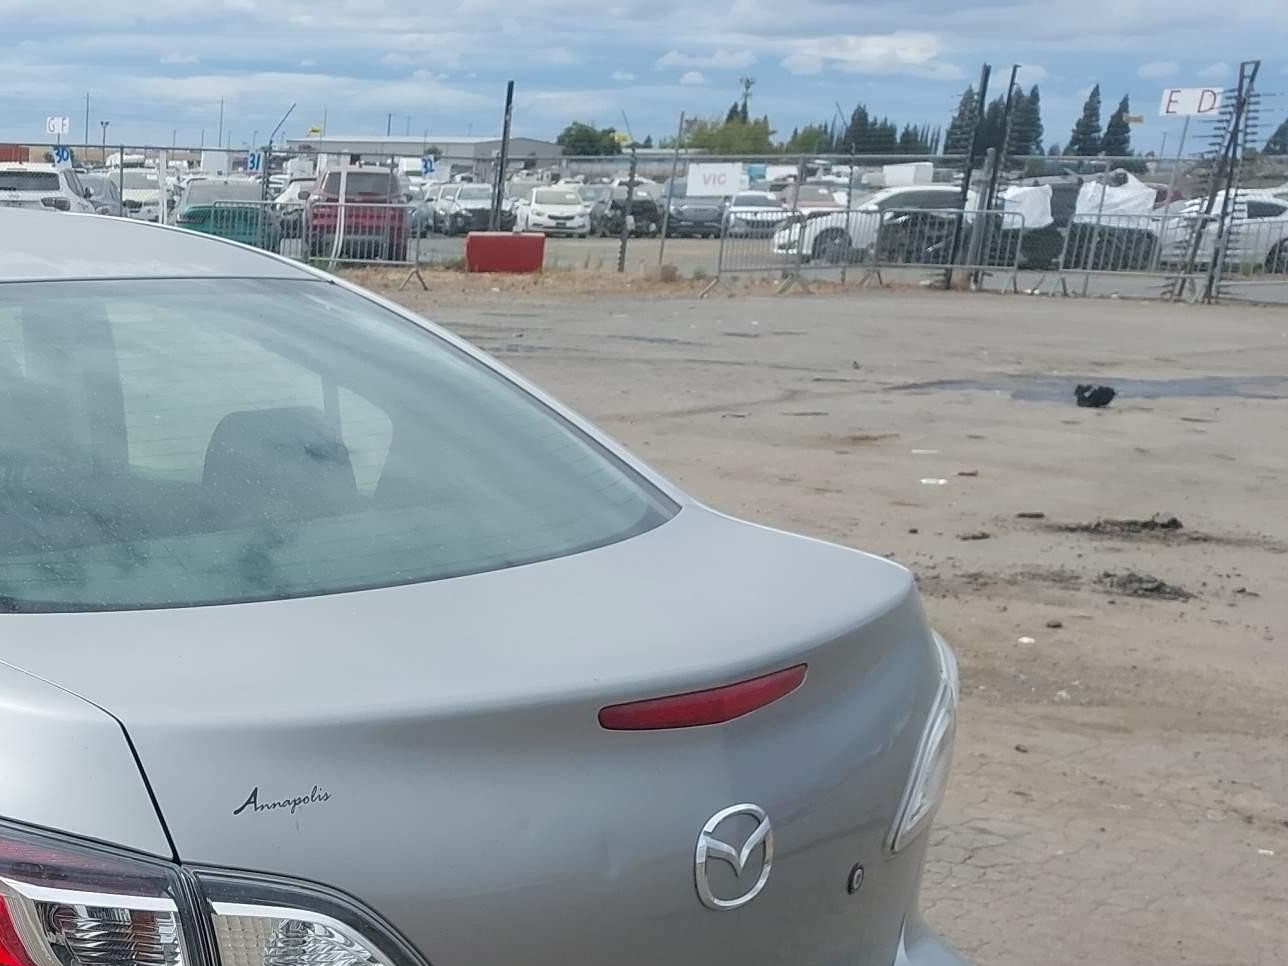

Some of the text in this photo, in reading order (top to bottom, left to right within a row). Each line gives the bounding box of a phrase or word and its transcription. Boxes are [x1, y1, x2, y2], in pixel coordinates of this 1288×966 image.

[1165, 89, 1217, 114] E D
[54, 146, 69, 164] 30
[249, 153, 261, 170] 31
[233, 785, 332, 815] Annapolis
